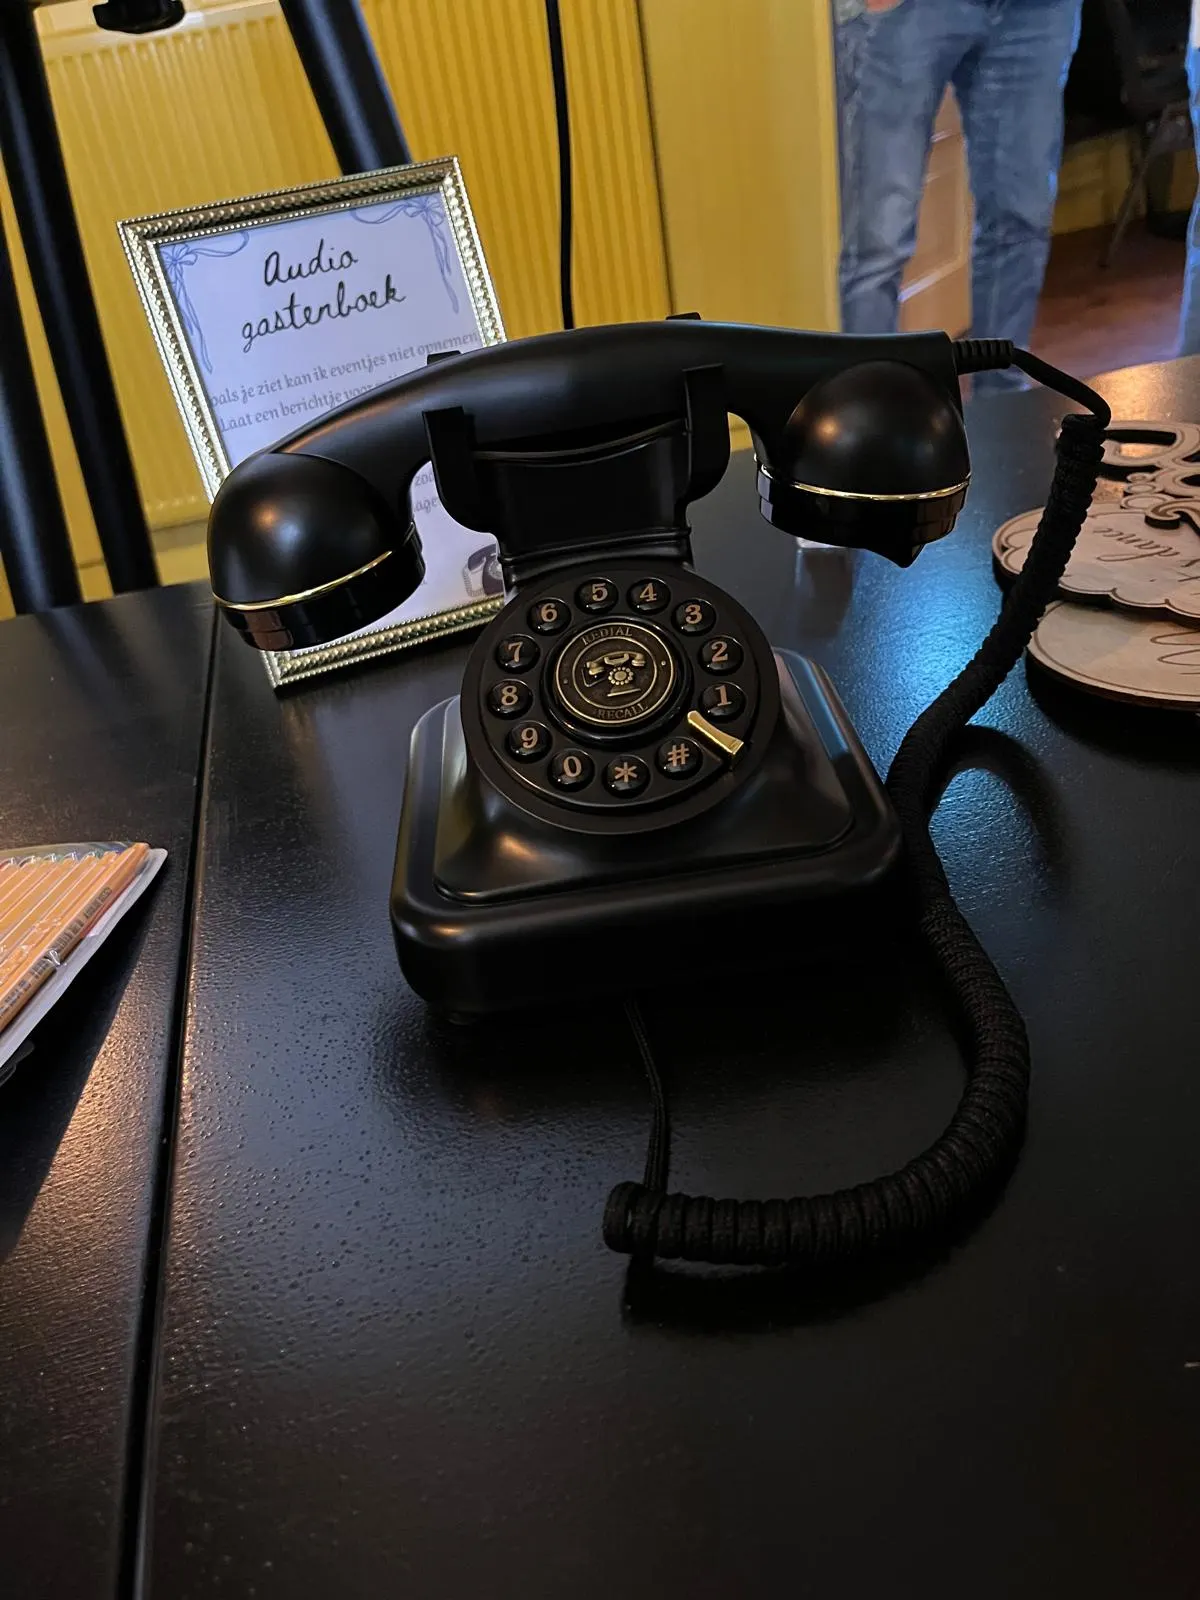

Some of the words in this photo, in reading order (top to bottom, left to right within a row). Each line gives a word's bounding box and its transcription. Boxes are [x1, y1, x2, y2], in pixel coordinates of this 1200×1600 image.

[264, 238, 358, 286] Audio
[211, 387, 240, 407] oals
[241, 384, 256, 405] je
[257, 378, 283, 396] ziet
[284, 373, 312, 388] kan
[314, 365, 328, 381] ik
[330, 353, 387, 377] eventjes
[388, 344, 416, 362] niet
[417, 331, 480, 355] opnemen
[220, 413, 252, 432] Laat
[255, 408, 279, 423] een
[280, 388, 342, 417] berichtje
[592, 583, 608, 602] 5
[641, 583, 657, 602] 4
[540, 602, 558, 622] 6
[685, 604, 702, 625] 3
[581, 626, 633, 646] REDIAL
[508, 641, 523, 663] 7
[711, 641, 728, 662] 2
[501, 685, 518, 706] 8
[715, 685, 732, 707] 1
[597, 703, 649, 719] RECALL
[521, 728, 538, 749] 9
[667, 743, 690, 766] #
[563, 756, 582, 778] 0
